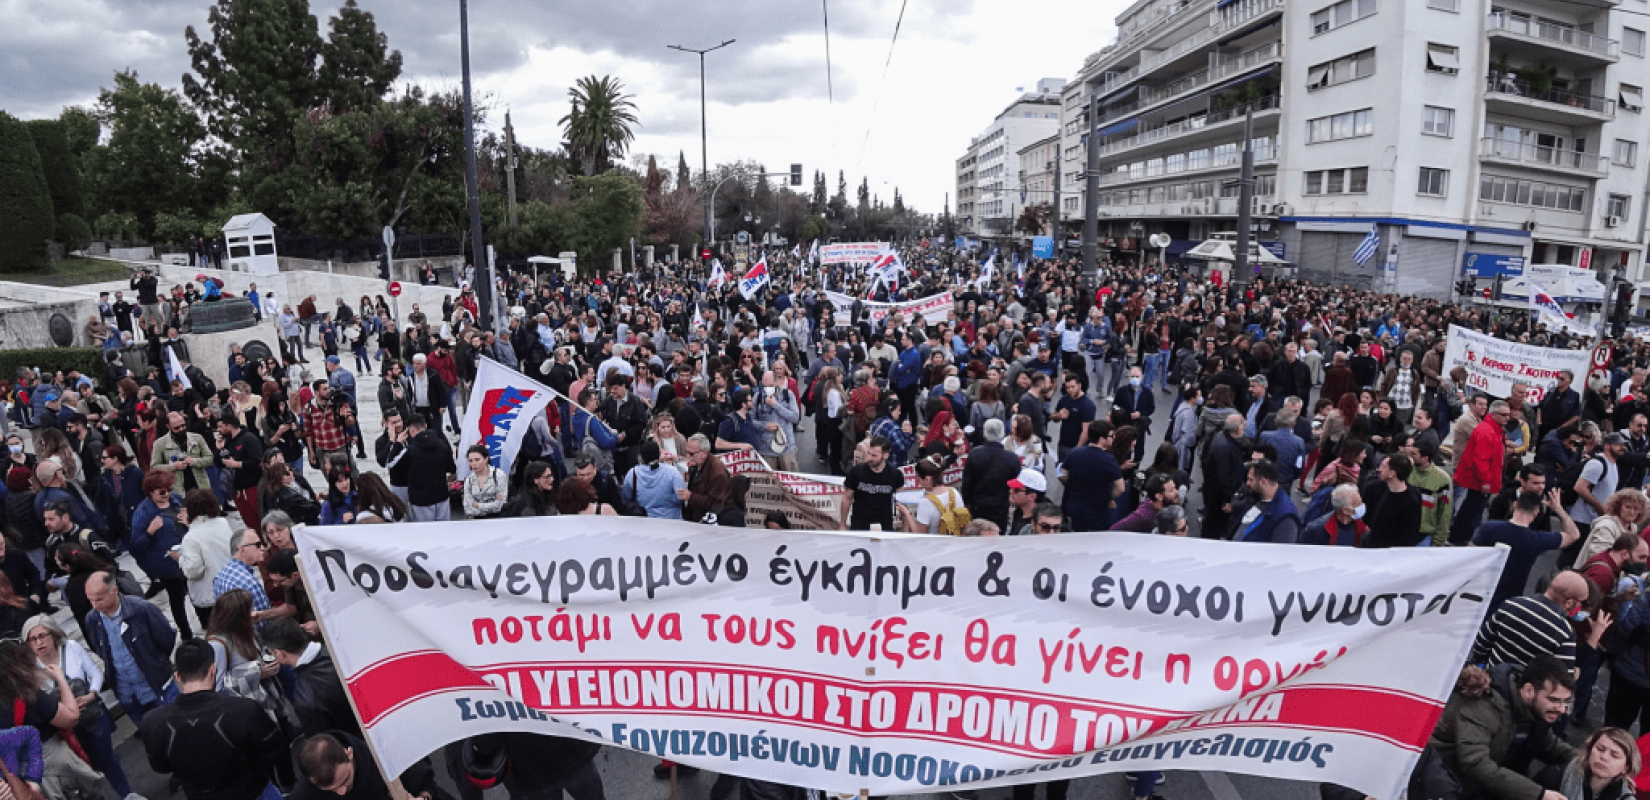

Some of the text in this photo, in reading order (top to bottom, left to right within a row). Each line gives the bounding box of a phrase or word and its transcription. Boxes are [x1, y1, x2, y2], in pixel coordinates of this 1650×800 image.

[315, 542, 748, 605] Προδιανεγραμμένο
[770, 545, 955, 609] έγκλημα
[978, 551, 1010, 597] &
[1033, 567, 1068, 602] οι
[1091, 562, 1244, 622] ένοχοι
[472, 607, 1347, 698] ποτάμι να τους πνίξει θα γίνει η οργή
[456, 698, 602, 738] Σωμα
[612, 724, 839, 771] Εργαζομένων
[1091, 734, 1333, 768] Ευαγγελισμός
[529, 669, 816, 719] ΥΓΕΙΟΝΟΜΙΚΟΙ
[825, 684, 893, 730] ΣΤΟ
[907, 690, 1057, 750] ΔΡΟΜΟ
[1070, 708, 1153, 753] ΤΟΥ
